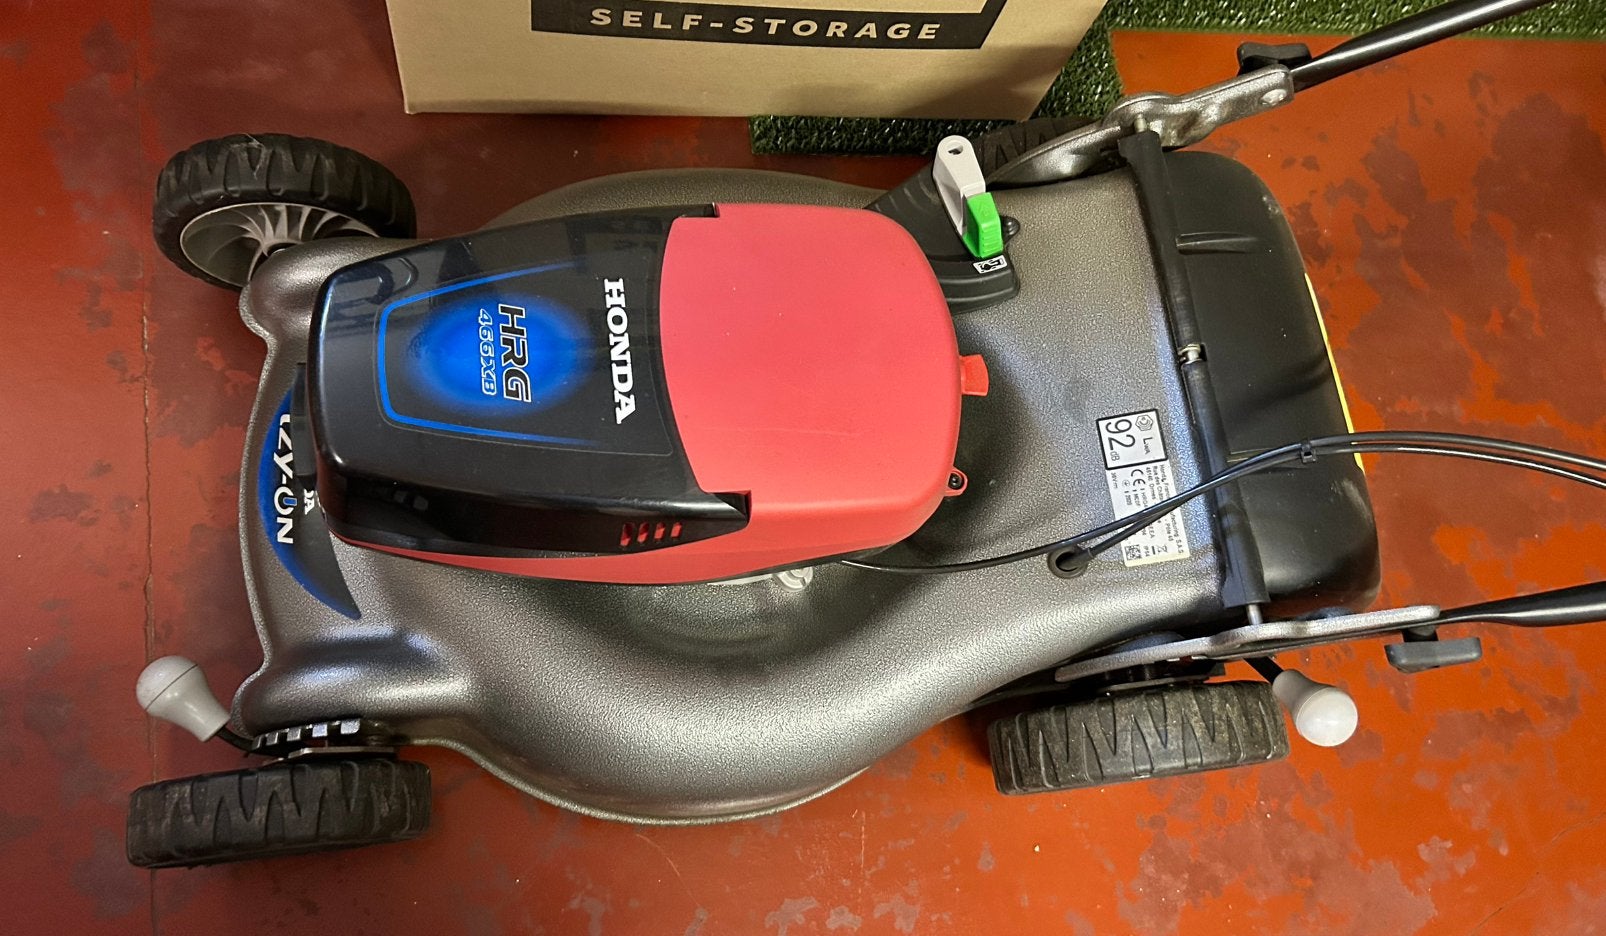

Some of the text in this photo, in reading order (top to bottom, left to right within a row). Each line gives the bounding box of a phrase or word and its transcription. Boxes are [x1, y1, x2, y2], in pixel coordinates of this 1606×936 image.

[590, 8, 942, 40] SELF-STORAGE
[478, 309, 497, 395] 466XB
[499, 304, 532, 402] HRG
[604, 278, 636, 424] HONDA
[1106, 419, 1136, 451] 92
